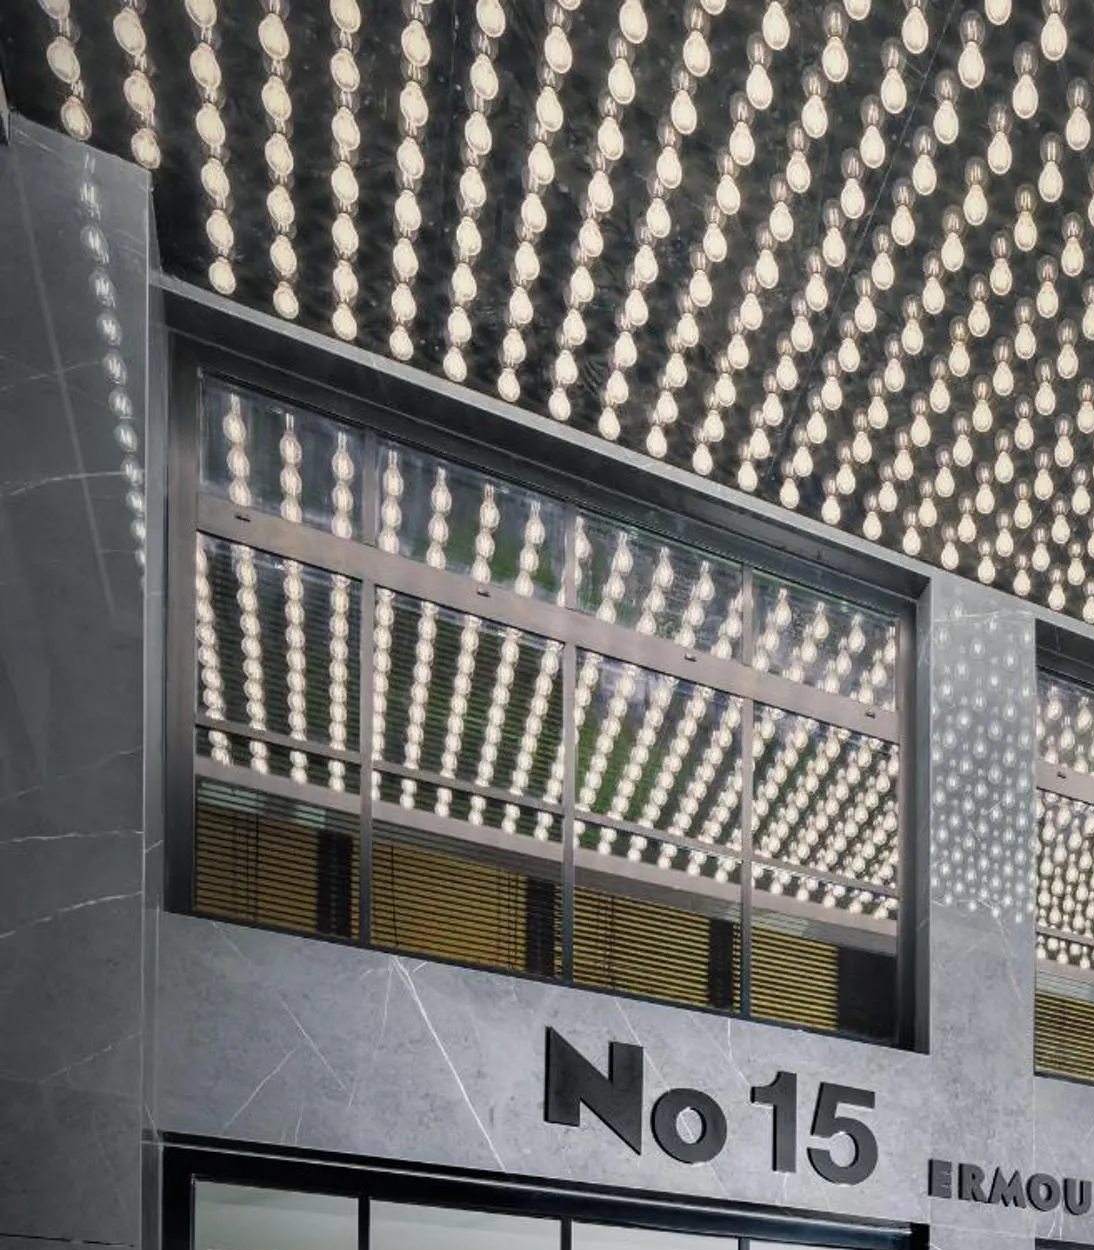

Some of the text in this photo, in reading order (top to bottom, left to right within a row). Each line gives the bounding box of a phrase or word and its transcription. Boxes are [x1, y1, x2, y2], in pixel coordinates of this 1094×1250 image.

[544, 1026, 878, 1185] No 15
[928, 1158, 1092, 1216] ERMOU
